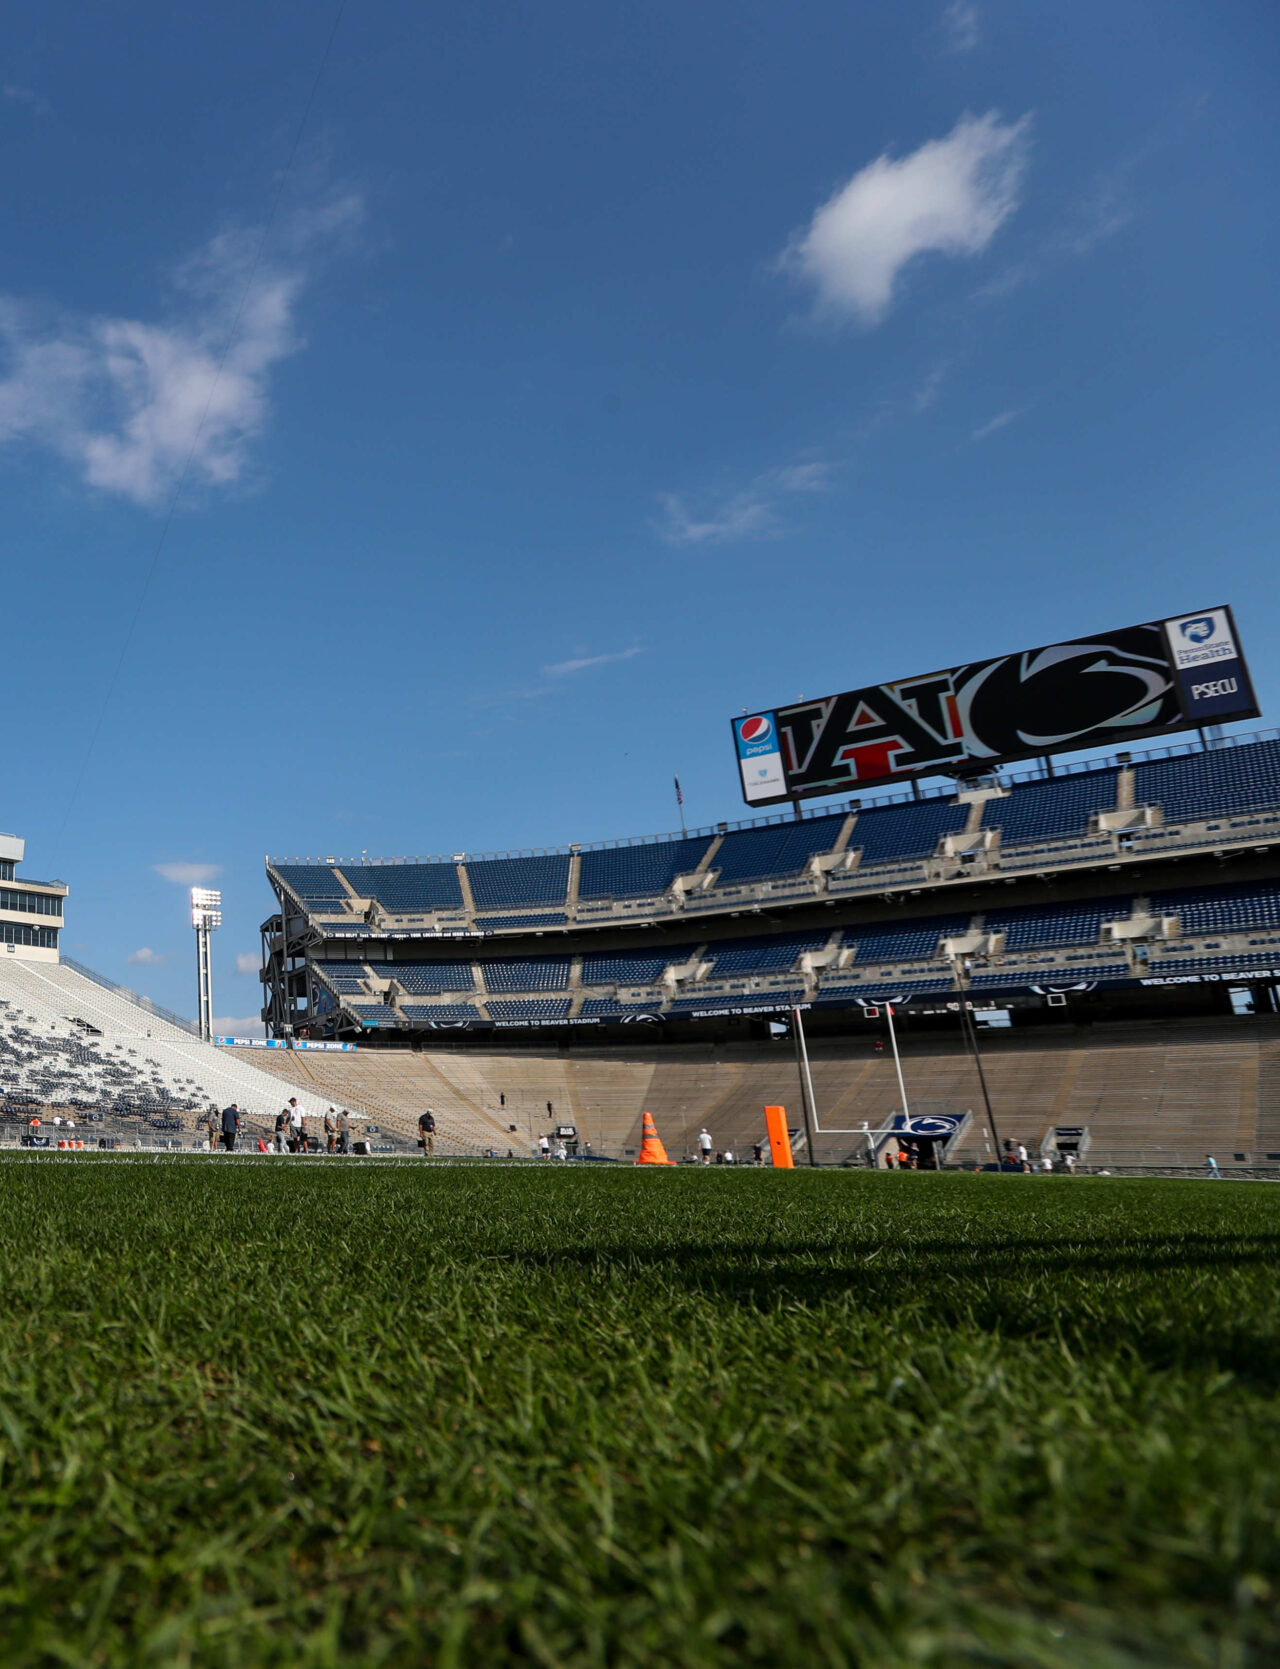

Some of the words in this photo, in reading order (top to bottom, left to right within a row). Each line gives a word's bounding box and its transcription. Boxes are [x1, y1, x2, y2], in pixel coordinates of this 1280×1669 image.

[1178, 646, 1233, 664] Health
[1191, 677, 1238, 700] PSECU
[746, 743, 773, 755] pepsi
[1140, 975, 1201, 986] WELCOME
[1202, 974, 1220, 982] TO
[1221, 969, 1271, 980] BEAVER
[692, 1009, 730, 1017] WELCOME
[743, 1006, 774, 1014] BEAVER
[233, 1038, 250, 1046] PEPSI
